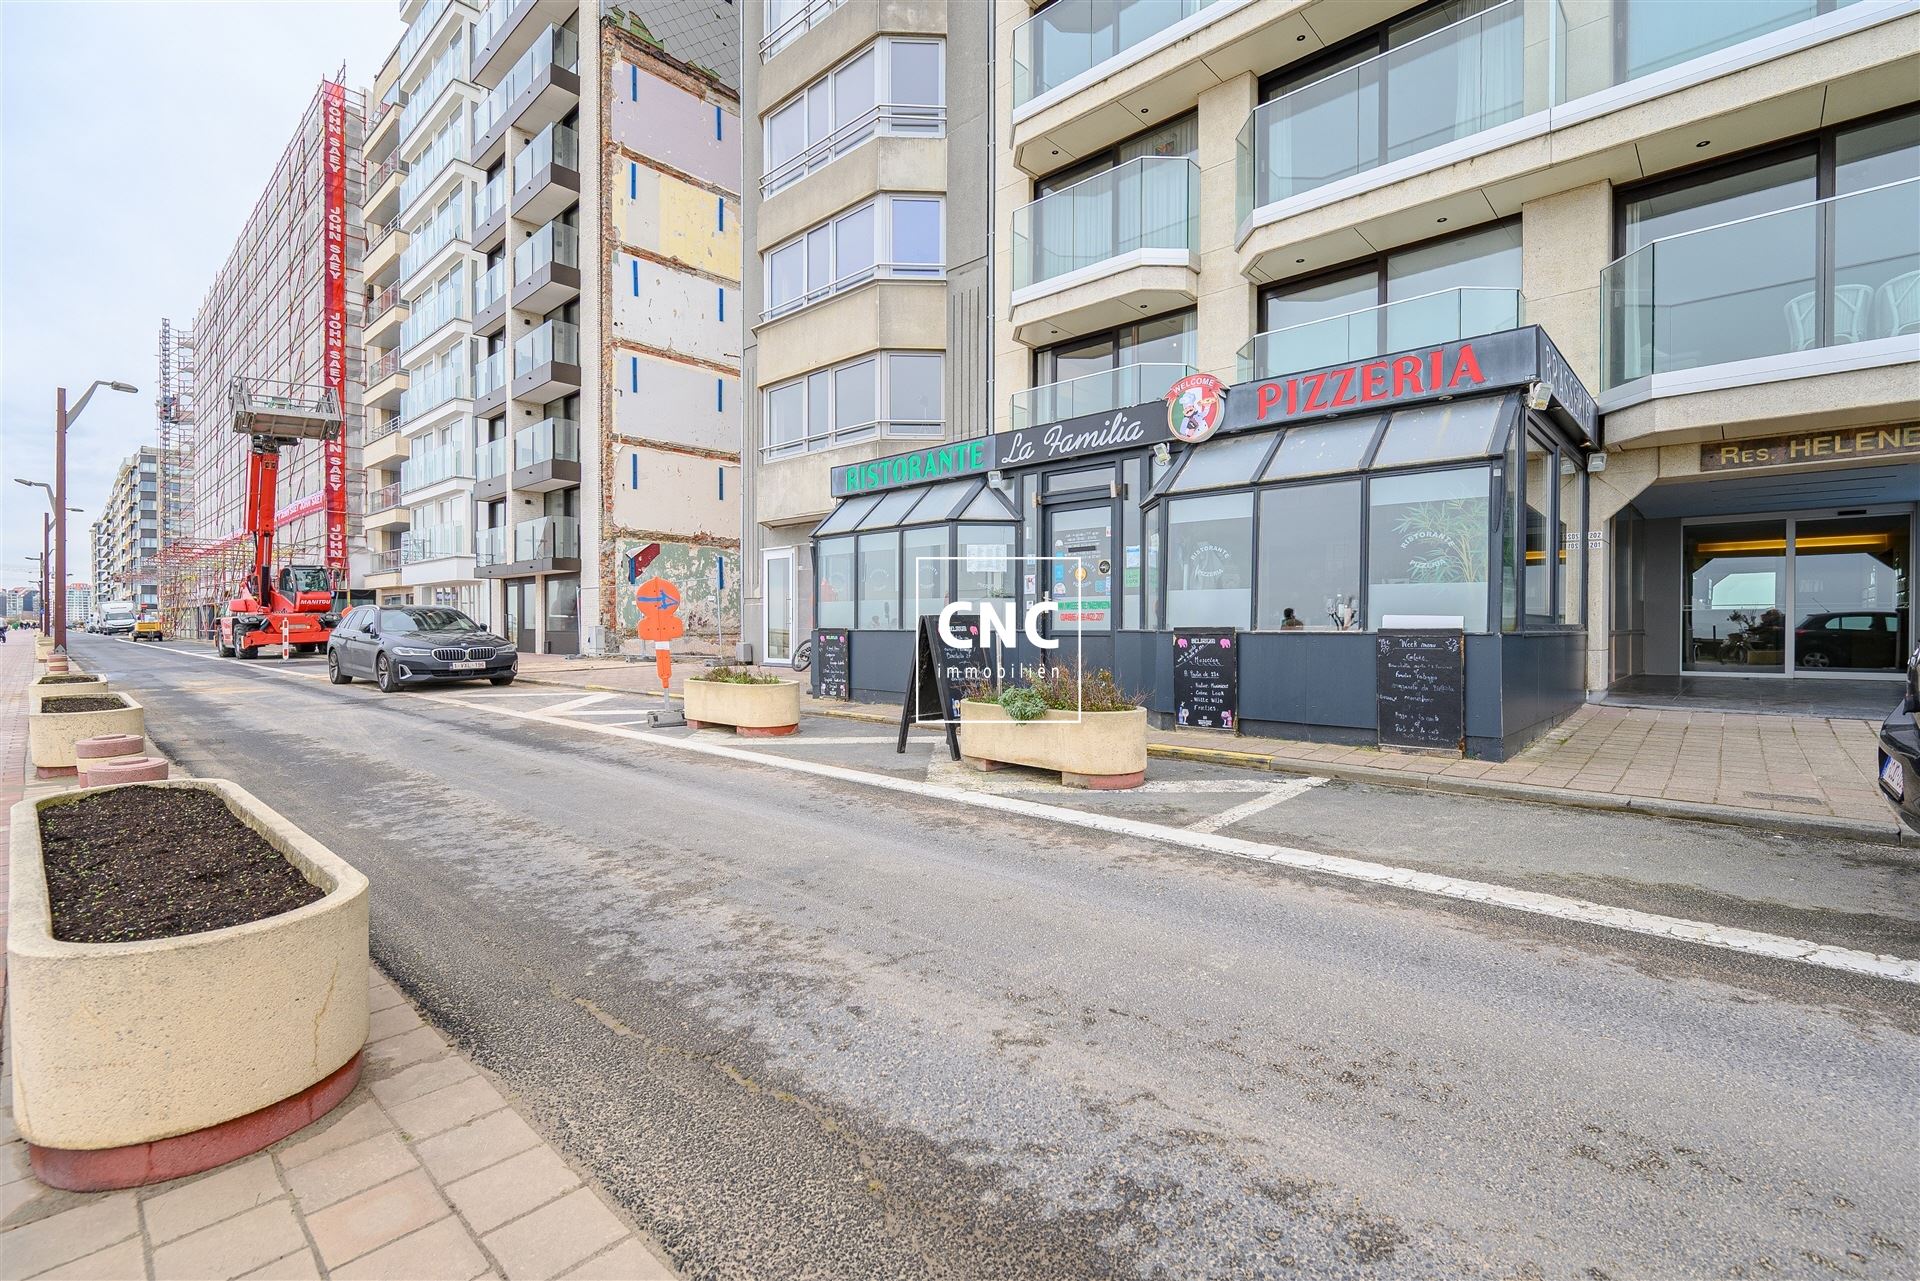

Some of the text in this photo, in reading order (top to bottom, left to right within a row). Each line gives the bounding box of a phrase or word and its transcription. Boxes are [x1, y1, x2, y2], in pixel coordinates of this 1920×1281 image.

[328, 98, 341, 173] JOHN SAEY
[328, 206, 342, 280] JOHN SAEY
[328, 312, 342, 386] JOHN SAEY
[1172, 377, 1215, 394] WELCOME
[1256, 343, 1487, 421] PIZZERIA
[1545, 345, 1591, 432] BRASSERIE
[1001, 412, 1145, 463] La Familia
[1790, 424, 1920, 458] HELENE
[329, 458, 342, 491] SAEY
[845, 440, 985, 492] RISTORANTE
[330, 524, 342, 558] JOHN
[1190, 544, 1230, 560] RISTORANTE
[1400, 531, 1456, 549] RISTORANTE
[1399, 638, 1418, 648] Week
